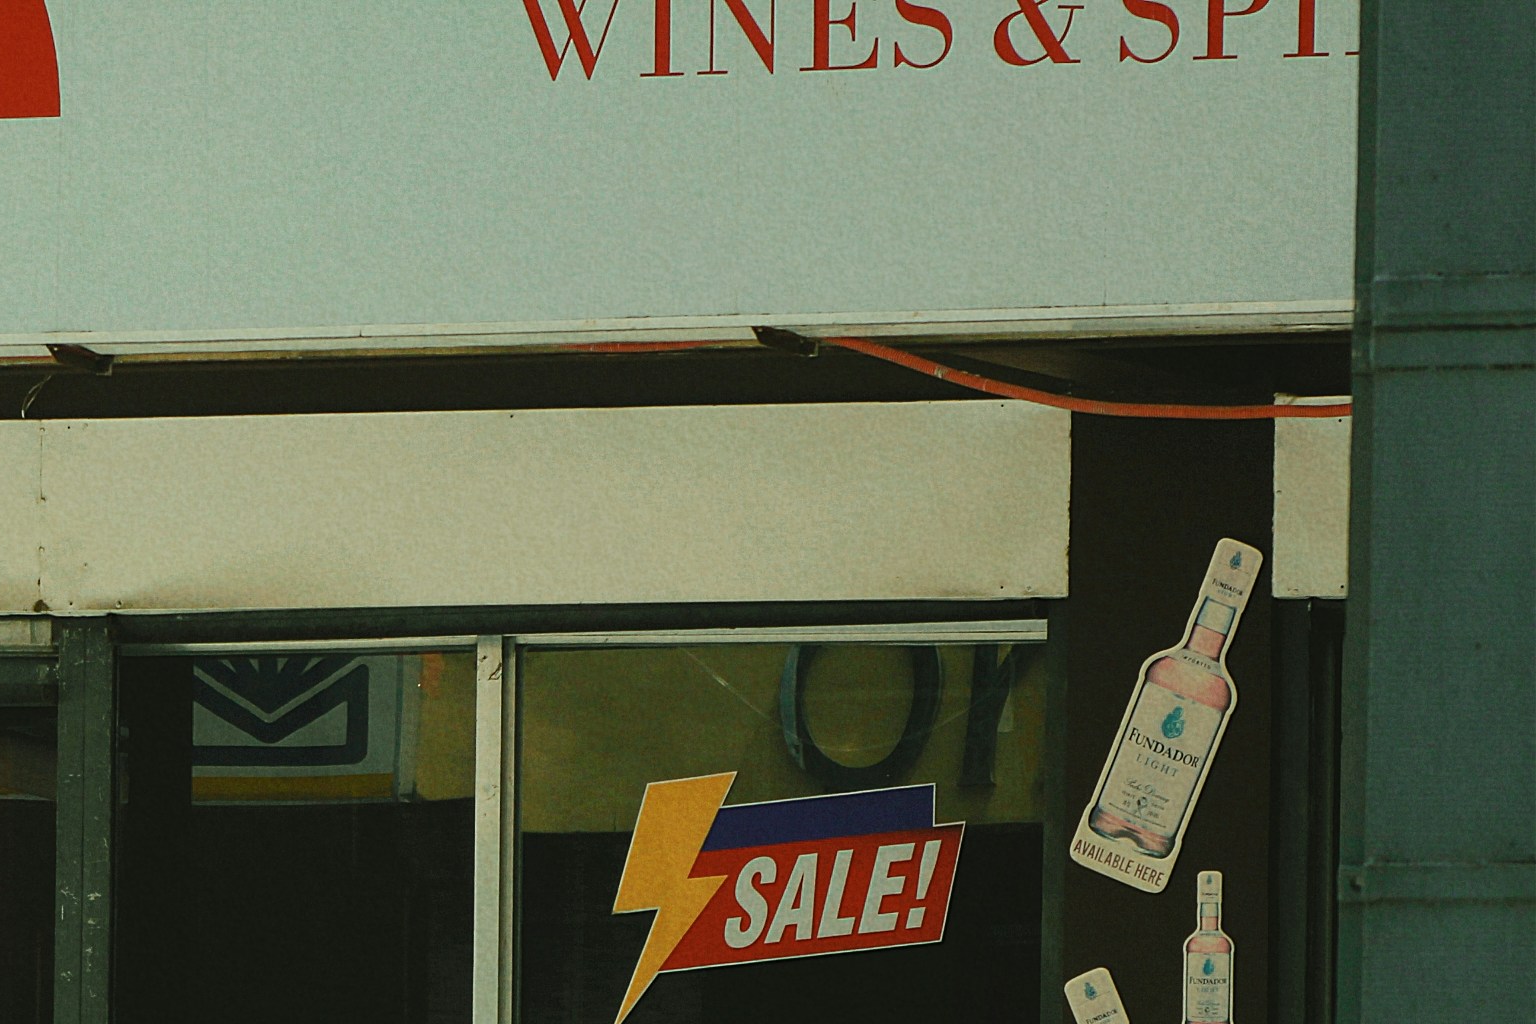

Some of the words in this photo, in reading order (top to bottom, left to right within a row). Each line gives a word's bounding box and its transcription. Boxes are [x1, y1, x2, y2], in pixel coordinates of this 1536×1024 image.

[521, 0, 954, 81] WINES
[992, 0, 1083, 67] &
[1118, 0, 1360, 62] SPI
[1128, 726, 1201, 769] FUNDADOR
[1136, 753, 1180, 778] LIGHT
[1073, 838, 1133, 875] AVAILABLE
[1134, 862, 1165, 887] HERE
[723, 839, 942, 950] SALE!
[1188, 976, 1228, 985] FUNDADOR
